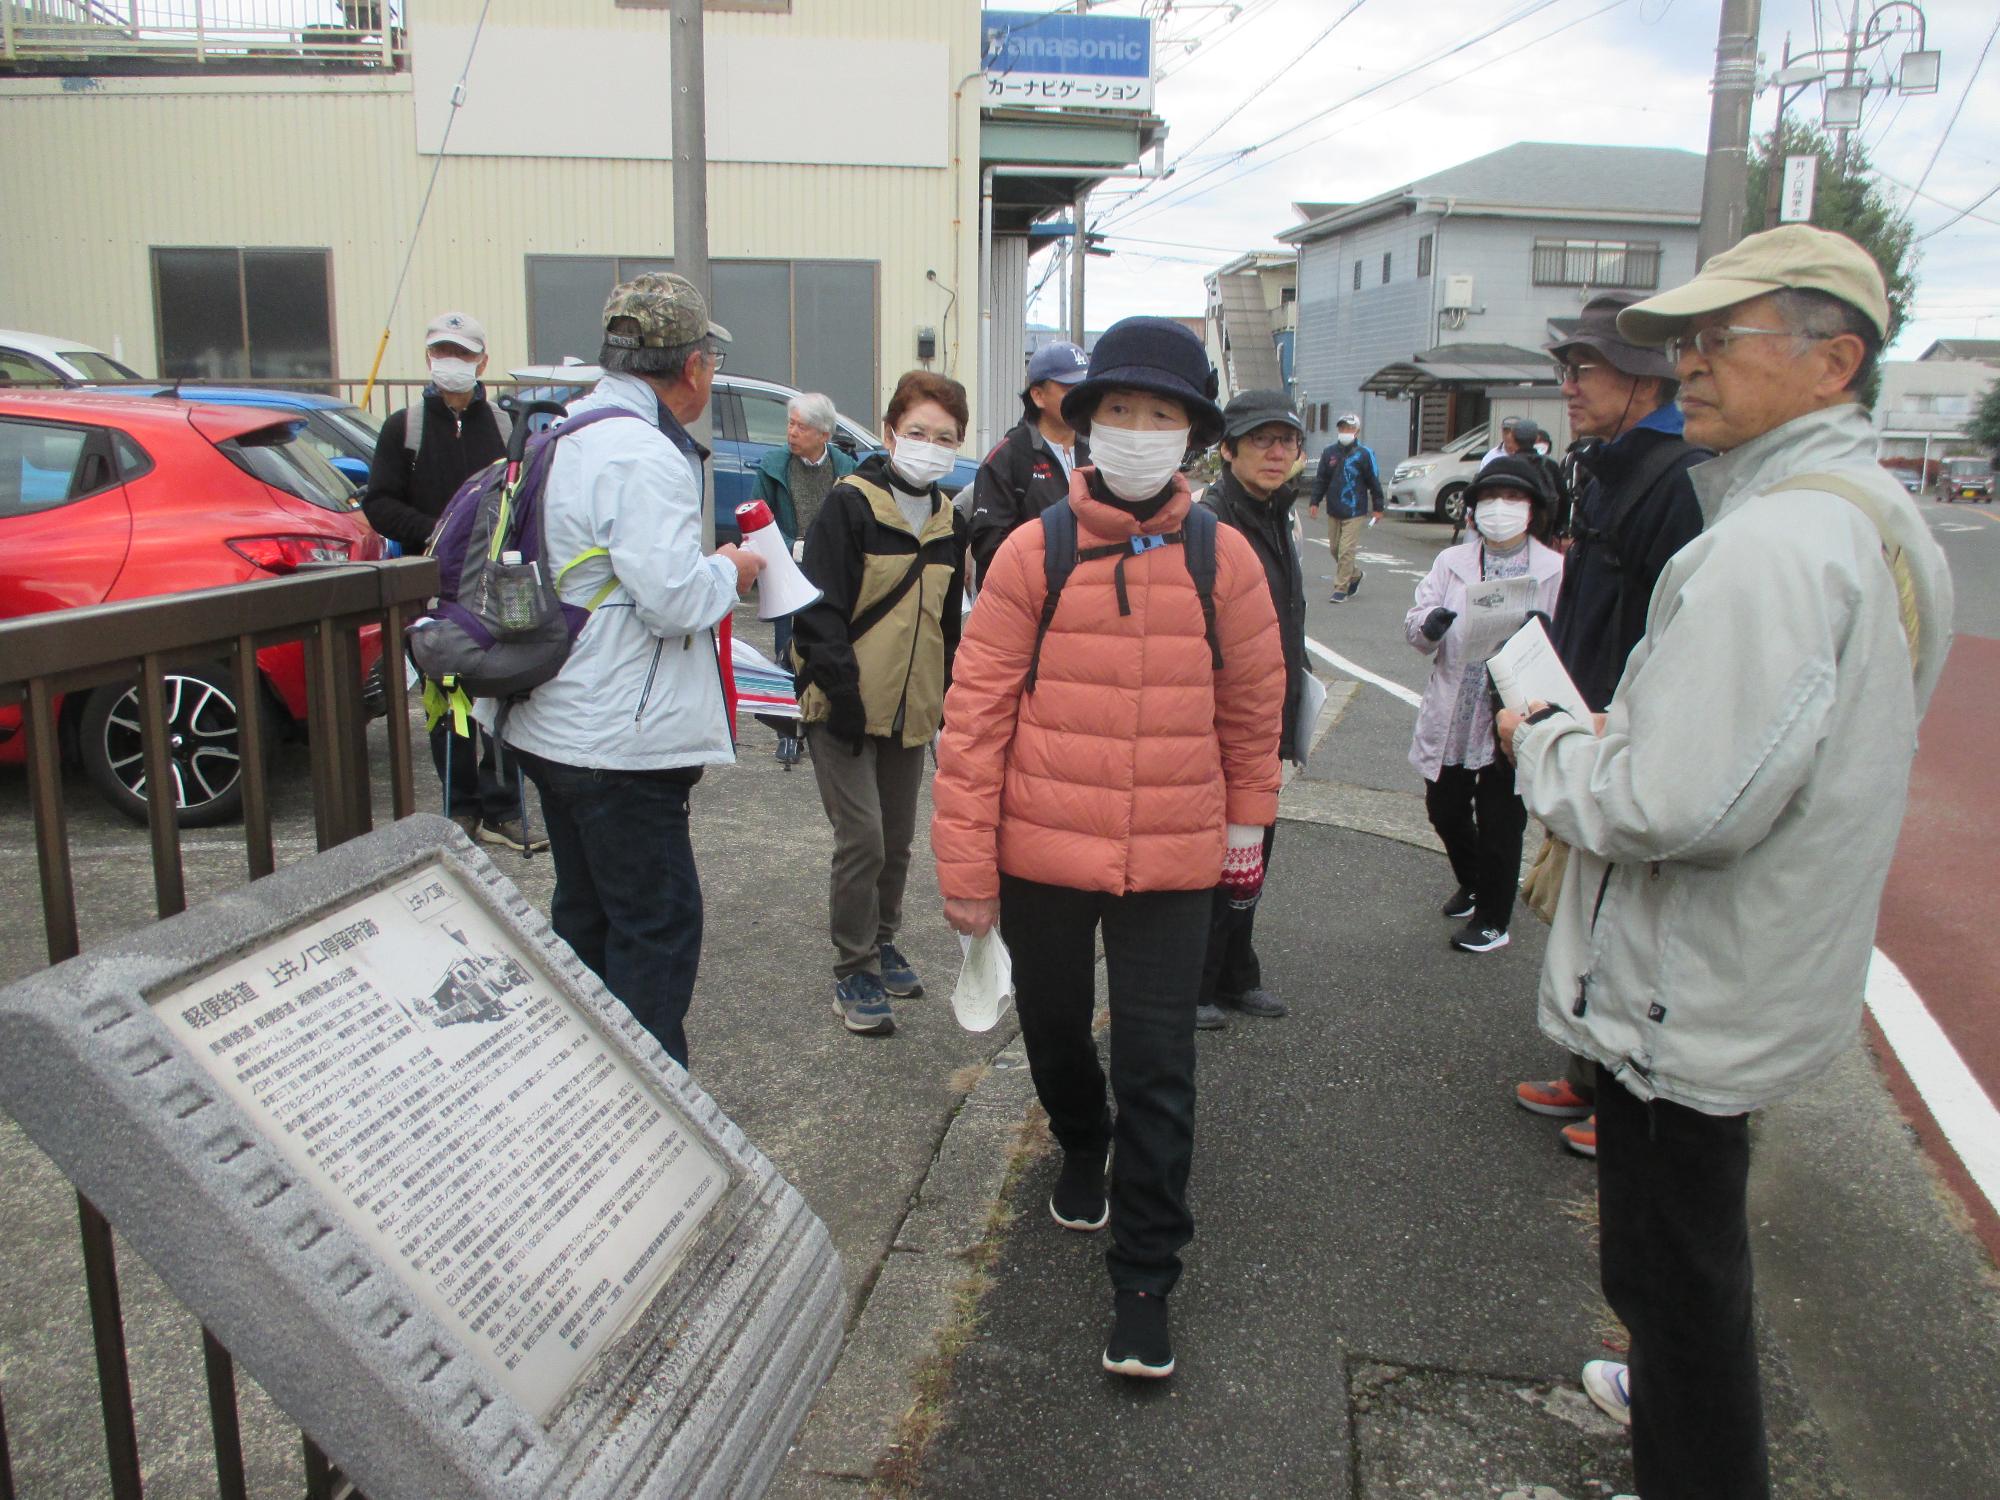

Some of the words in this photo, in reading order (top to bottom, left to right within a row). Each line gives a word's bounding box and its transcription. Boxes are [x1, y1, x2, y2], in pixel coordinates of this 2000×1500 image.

[988, 78, 1141, 100] カーナビゲーション
[179, 980, 260, 1031] 軽便鉄道
[260, 916, 382, 988] 上井ノ口停留所跡
